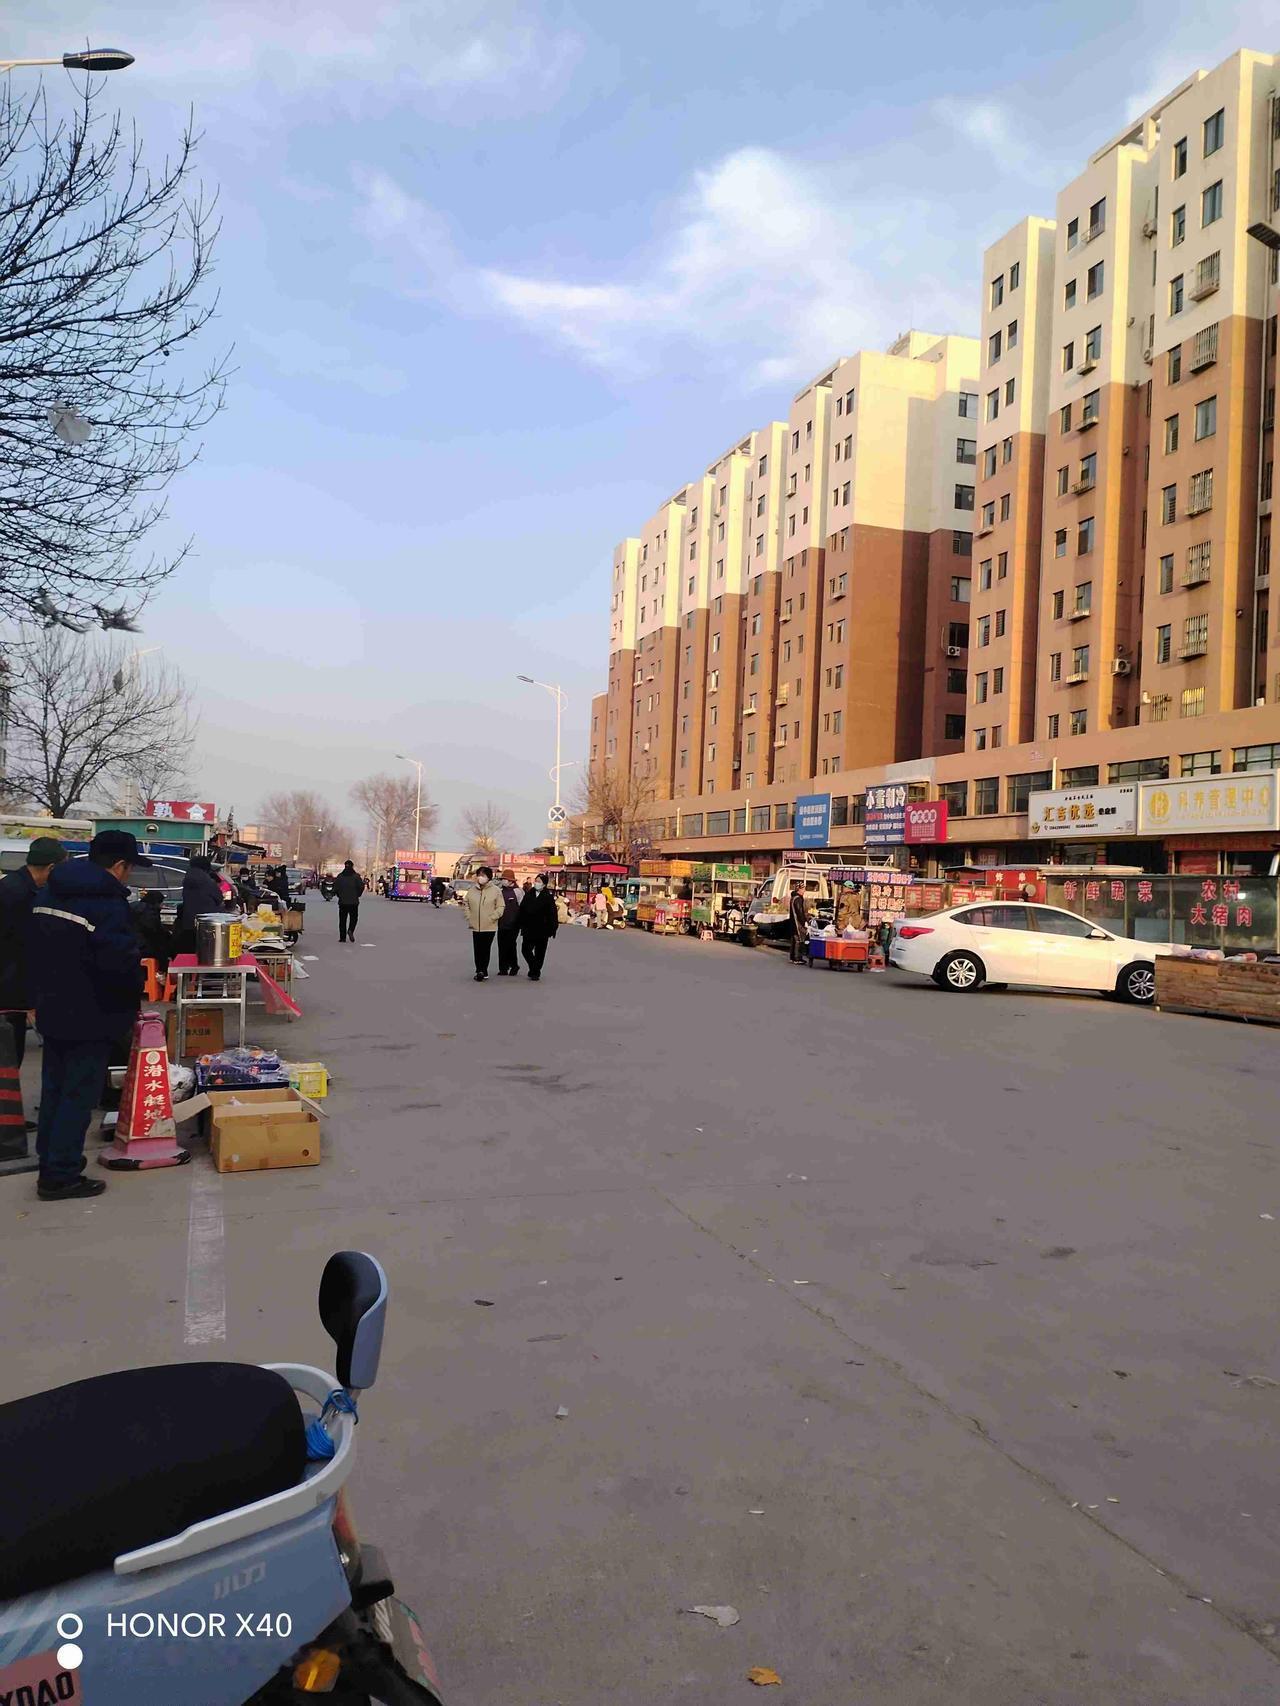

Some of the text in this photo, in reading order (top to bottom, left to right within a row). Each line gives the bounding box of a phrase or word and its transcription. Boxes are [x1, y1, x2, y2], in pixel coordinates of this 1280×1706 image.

[865, 786, 906, 810] 小董制冷
[1063, 880, 1153, 902] 新鲜蔬菜
[1201, 880, 1241, 902] 农村
[1191, 903, 1252, 927] 大猪肉
